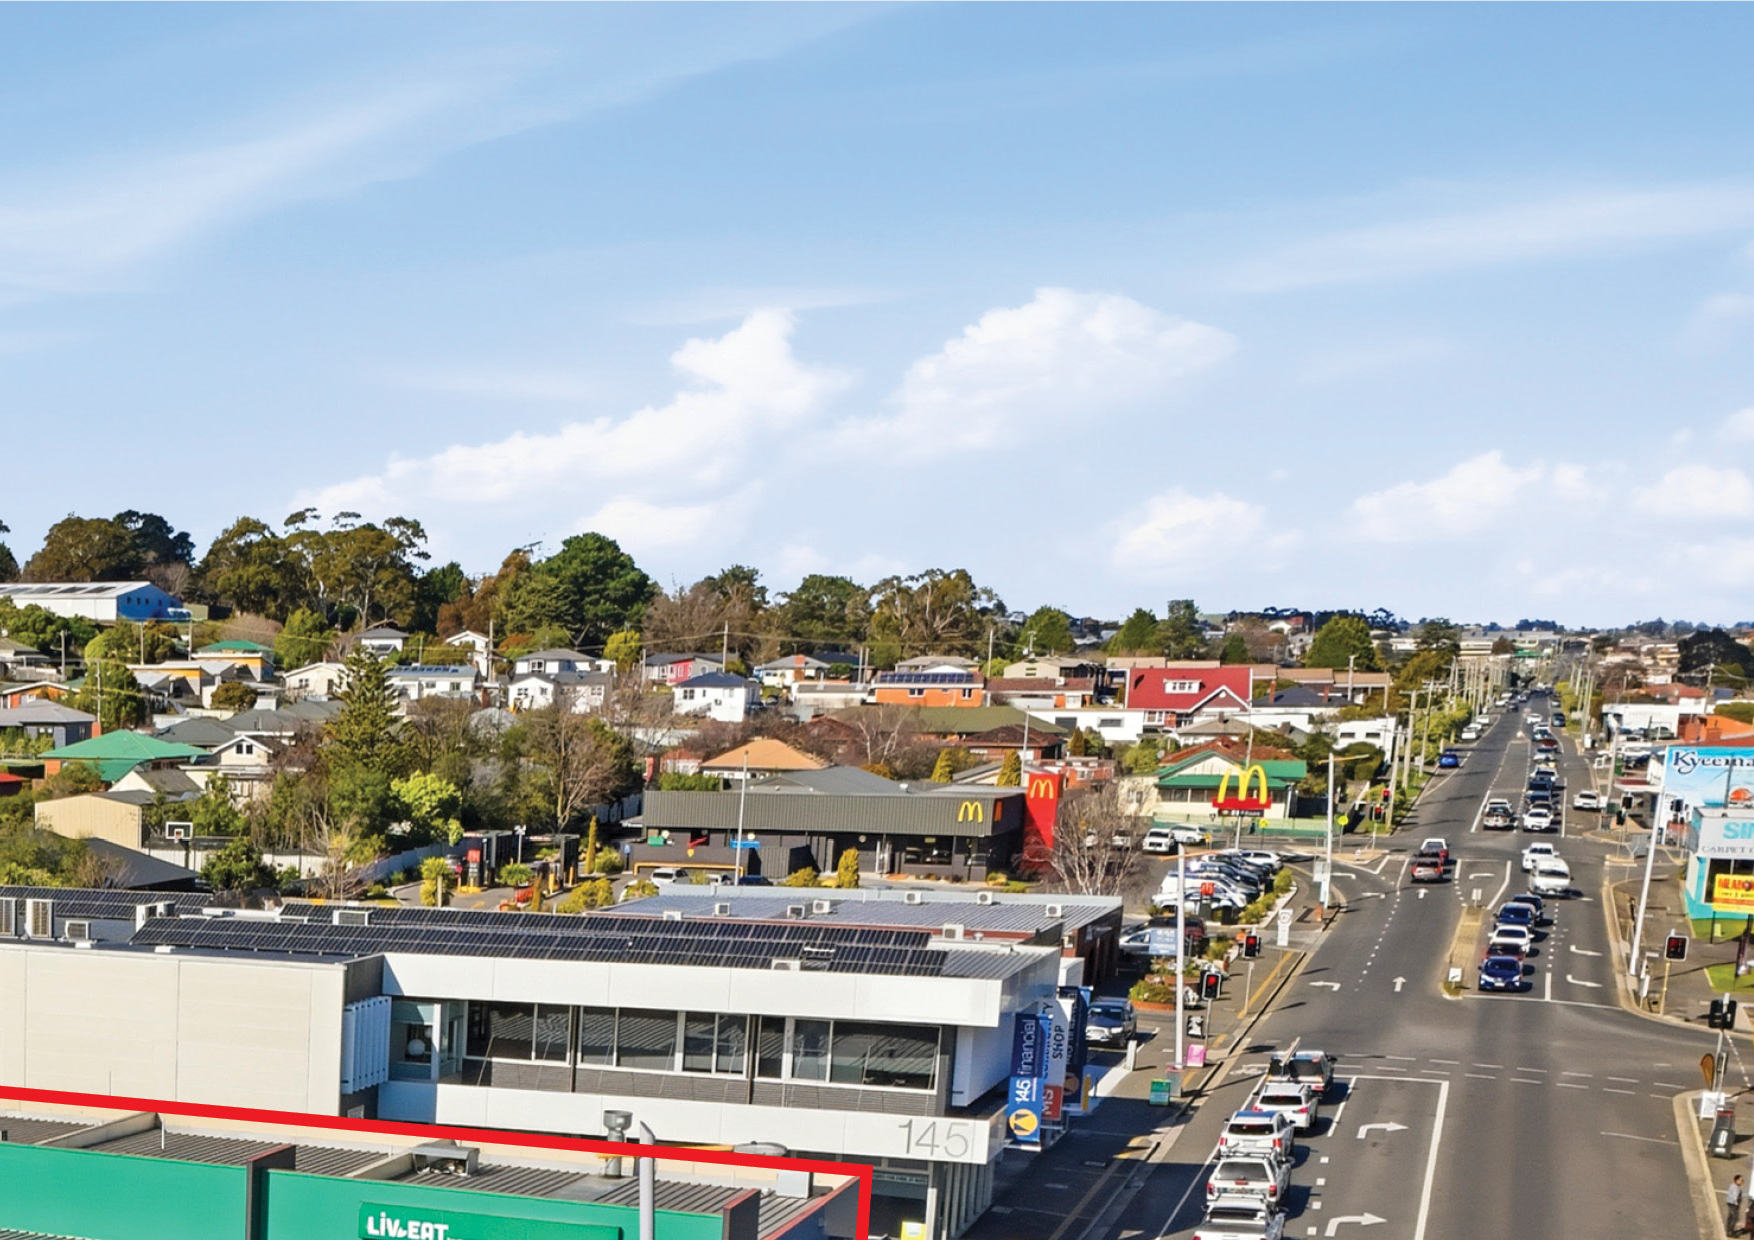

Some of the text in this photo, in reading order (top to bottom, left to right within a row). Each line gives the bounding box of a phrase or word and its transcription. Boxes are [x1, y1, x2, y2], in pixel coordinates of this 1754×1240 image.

[1722, 822, 1754, 839] SI
[1016, 1018, 1036, 1076] financial
[1052, 1024, 1065, 1060] SHOP
[1014, 1077, 1033, 1102] 145
[898, 1118, 969, 1158] 145
